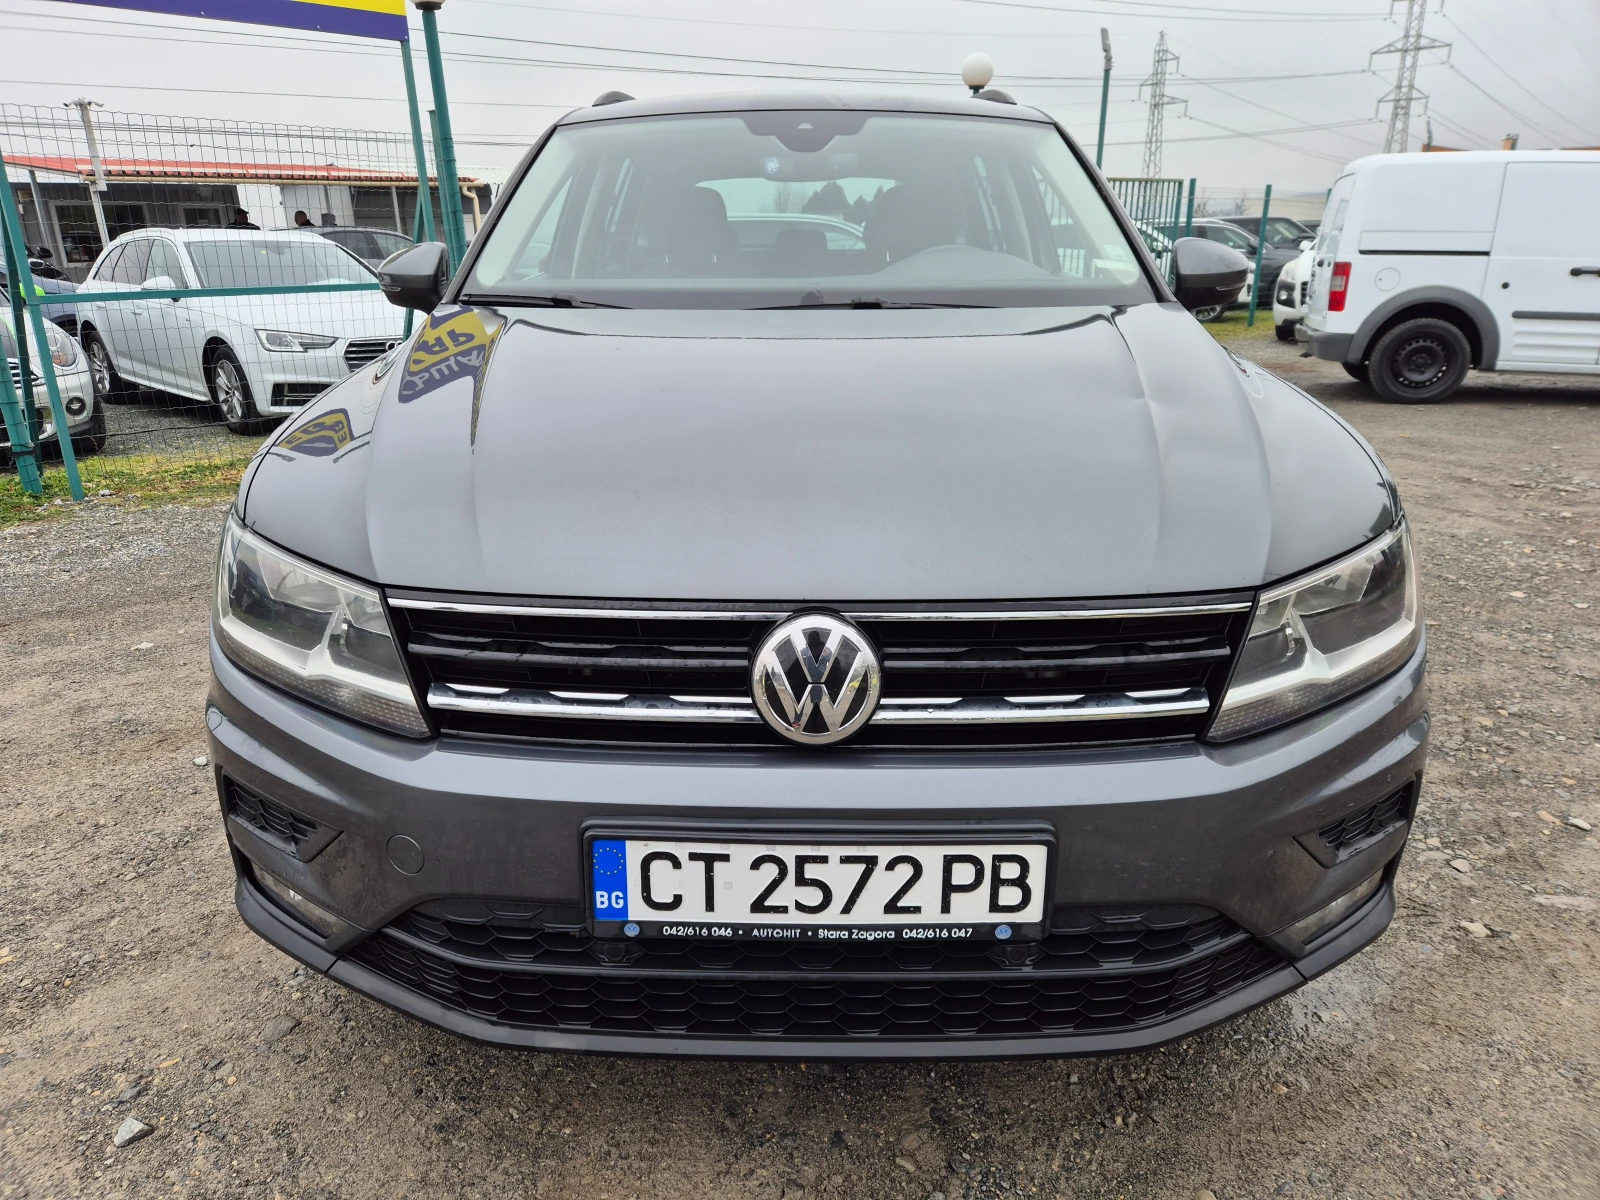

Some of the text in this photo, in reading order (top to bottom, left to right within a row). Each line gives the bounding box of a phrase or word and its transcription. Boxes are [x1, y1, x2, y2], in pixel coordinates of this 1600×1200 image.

[640, 851, 1032, 915] CT 2572 PB
[595, 890, 624, 909] BG
[662, 926, 973, 941] 042/616 046 AUTOHIT Stara Zagora 042/616 047
